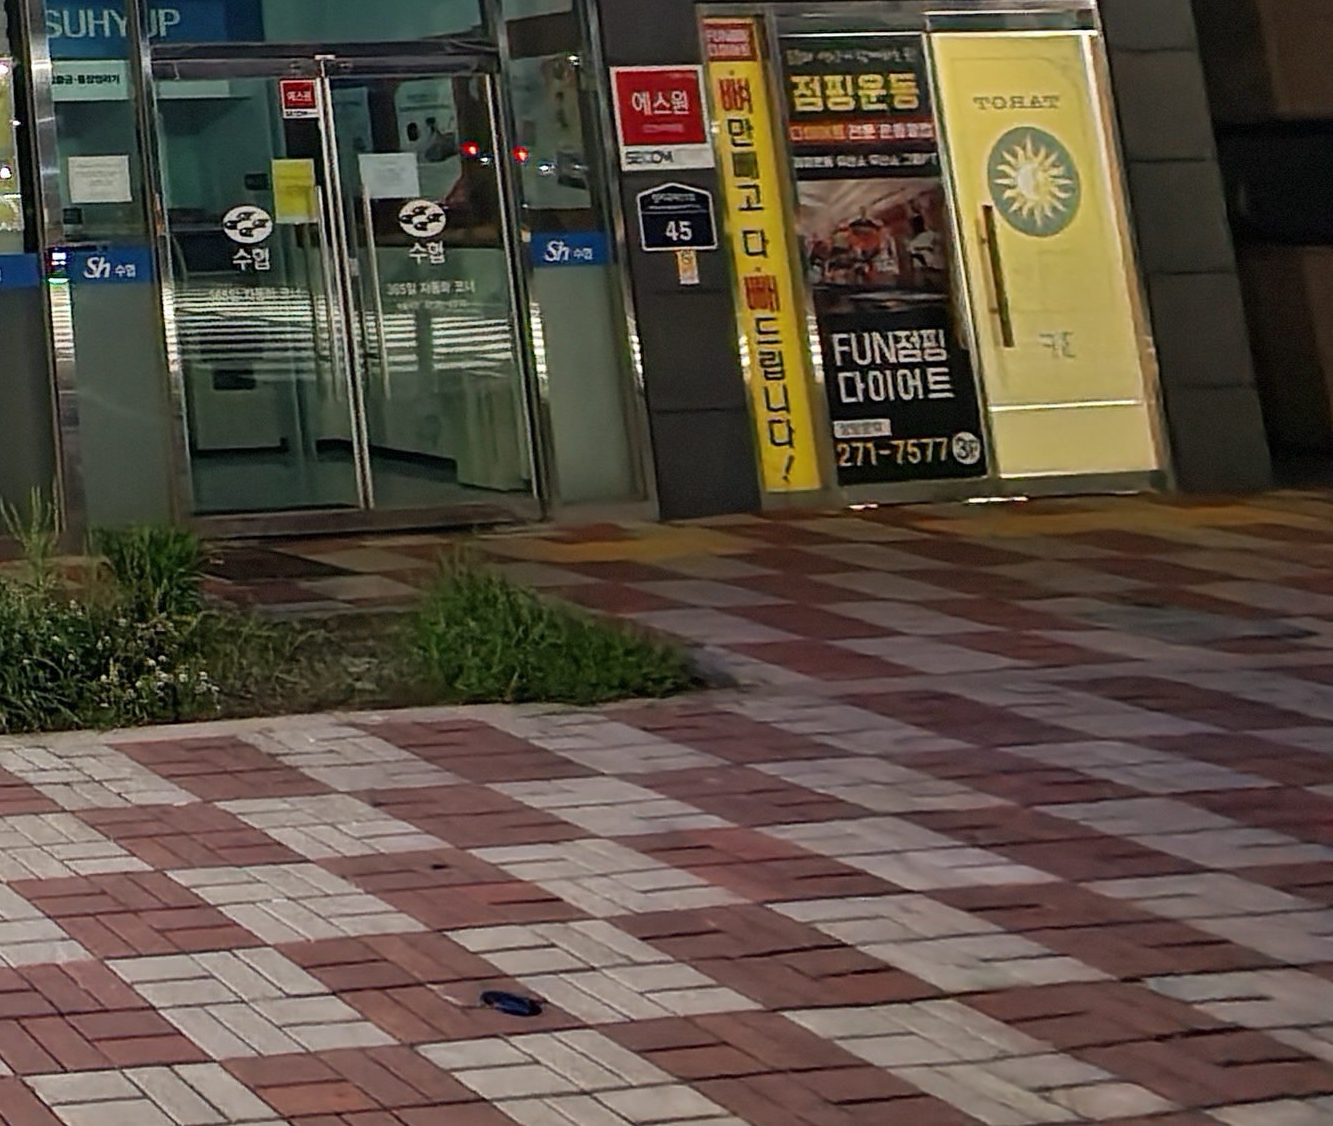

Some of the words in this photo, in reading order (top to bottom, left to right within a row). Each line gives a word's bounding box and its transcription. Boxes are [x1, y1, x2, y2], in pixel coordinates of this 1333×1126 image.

[631, 90, 691, 116] 에스원
[789, 72, 920, 112] 점핑운동
[665, 220, 693, 242] 45
[232, 246, 271, 272] 수협
[408, 240, 447, 265] 수협
[543, 240, 570, 262] Sh
[83, 256, 112, 279] Sh
[832, 328, 949, 367] FUN점핑
[837, 367, 956, 404] 다이어트
[836, 436, 950, 467] 271-7577
